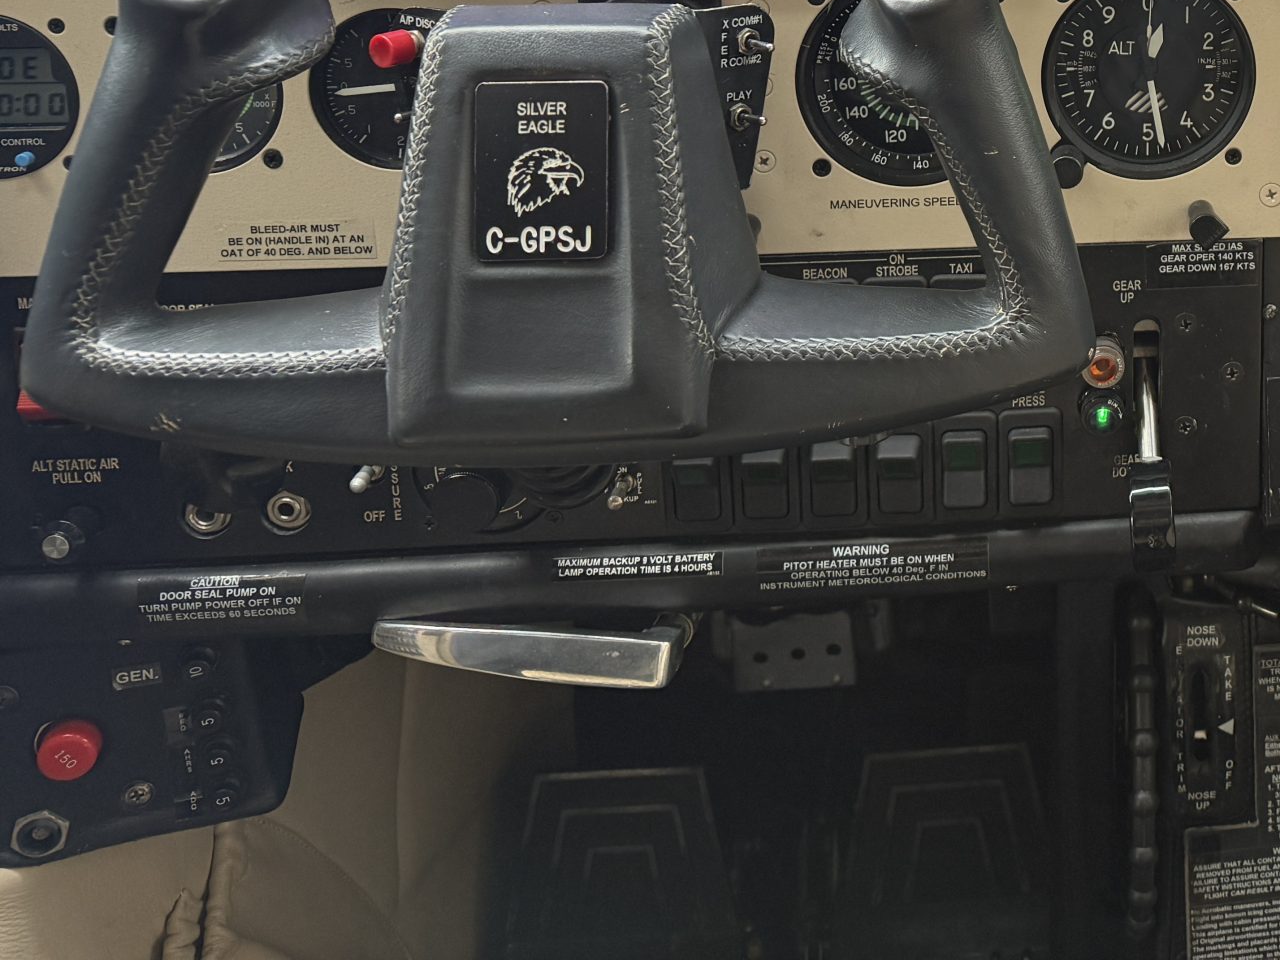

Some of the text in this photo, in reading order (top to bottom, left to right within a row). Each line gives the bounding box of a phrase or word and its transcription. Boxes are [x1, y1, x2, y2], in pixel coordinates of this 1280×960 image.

[516, 102, 566, 116] SILVER
[518, 120, 566, 134] EAGLE
[830, 197, 920, 210] MANEUVERING
[250, 224, 340, 234] BLEED-AIR MUST
[246, 237, 262, 245] ON
[265, 236, 312, 247] (HANDLE
[315, 235, 330, 245] IN)
[349, 235, 364, 243] AN
[486, 226, 592, 254] C-GPSJ
[221, 249, 243, 257] OAT
[265, 248, 276, 256] 40
[279, 248, 304, 256] DEG.
[307, 247, 330, 255] AND
[334, 246, 373, 254] BELOW
[803, 267, 848, 279] BEACON
[876, 264, 919, 276] STROBE
[949, 262, 973, 274] TAXI
[1112, 280, 1142, 292] GEAR
[1120, 292, 1134, 302] UP
[833, 544, 890, 556] WARNING
[190, 577, 240, 588] CAUTION
[160, 587, 276, 601] DOOR SEAL PUMP ON
[115, 667, 160, 685] GEN.
